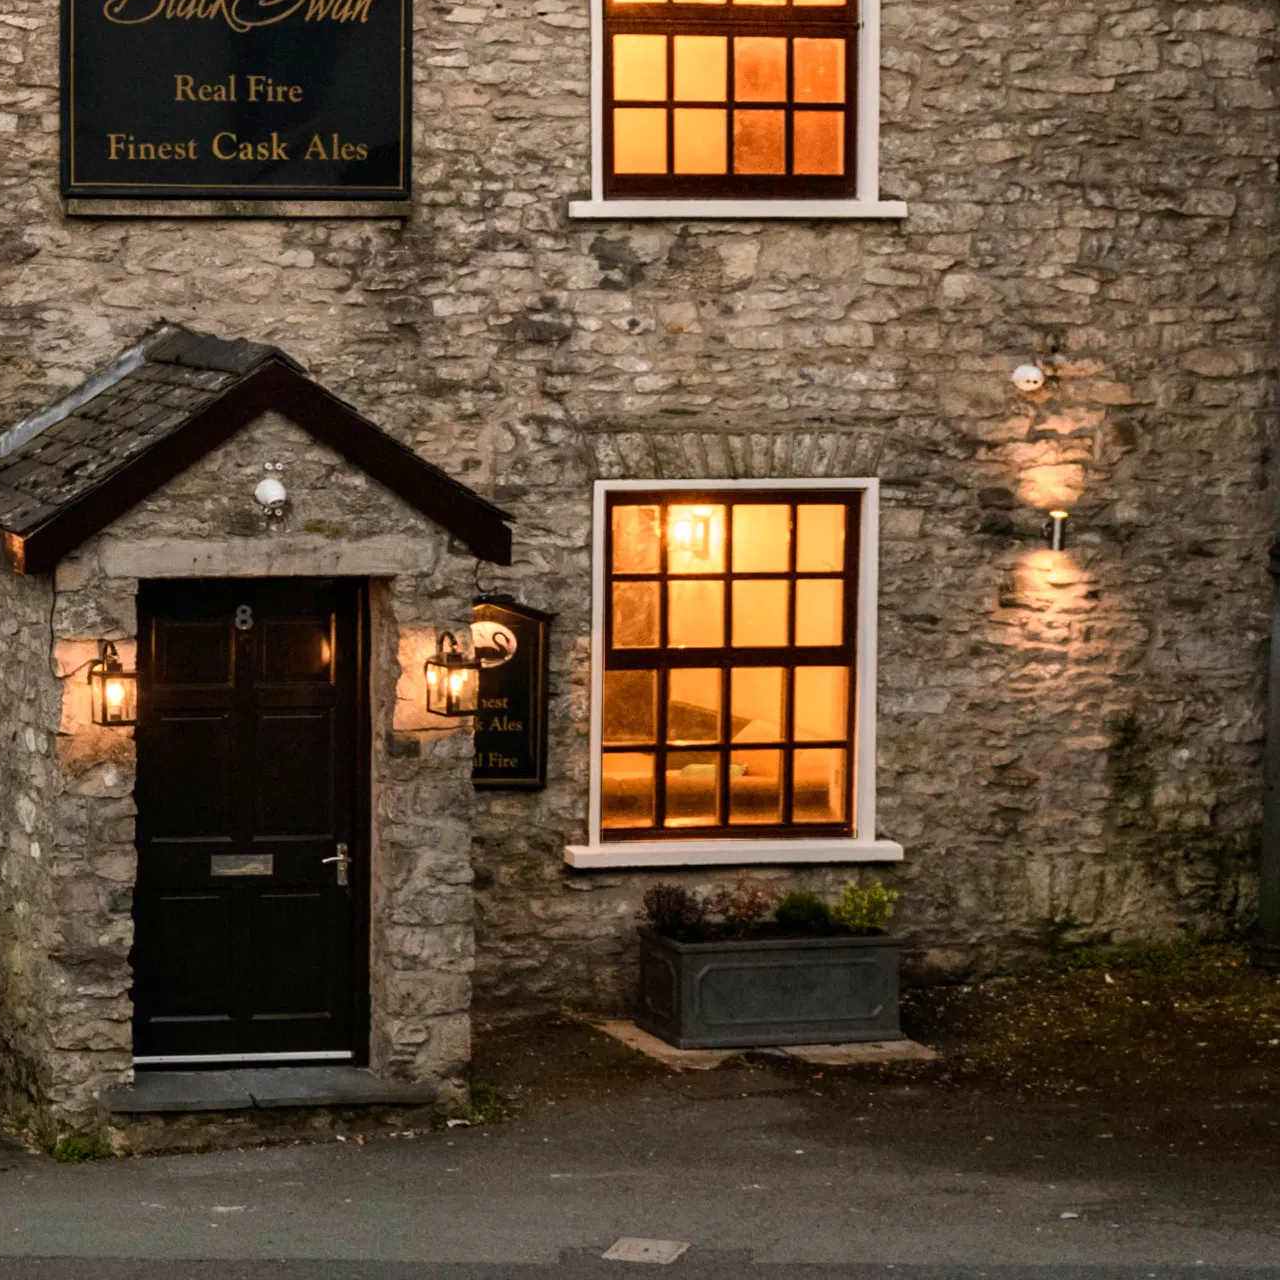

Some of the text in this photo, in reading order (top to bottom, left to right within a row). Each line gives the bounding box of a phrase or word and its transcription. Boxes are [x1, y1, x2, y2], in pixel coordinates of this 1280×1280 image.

[174, 74, 304, 103] Real Fire
[107, 131, 368, 161] Finest Cask Ales
[235, 604, 254, 630] 8
[488, 715, 524, 732] Ales
[488, 752, 520, 768] Fire
